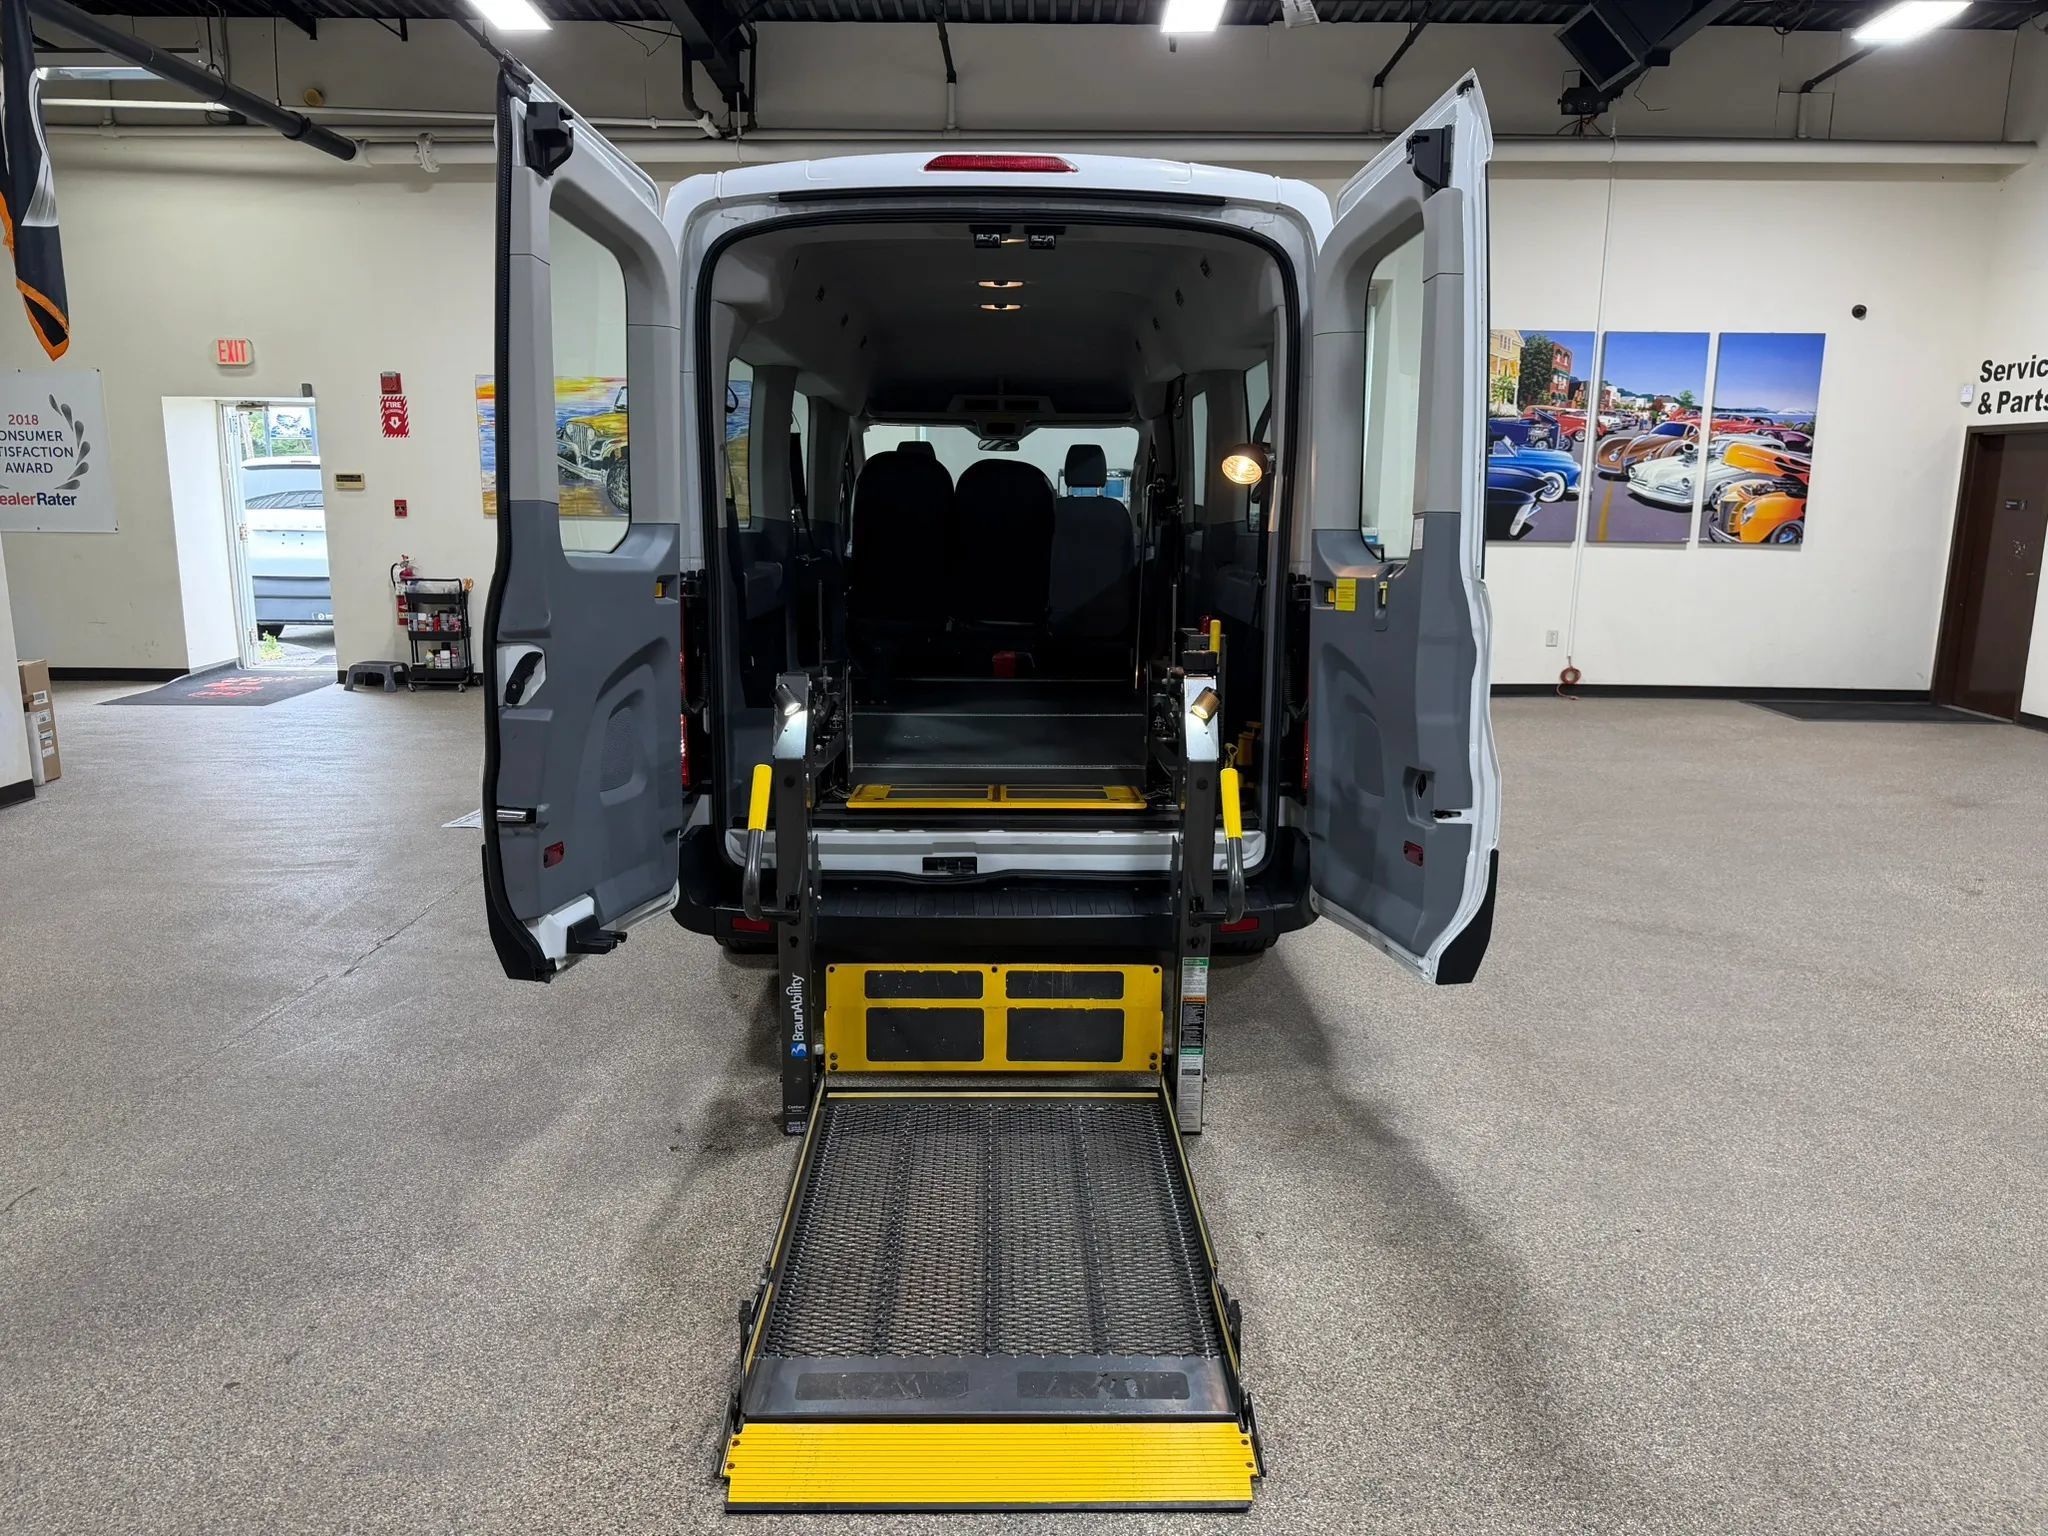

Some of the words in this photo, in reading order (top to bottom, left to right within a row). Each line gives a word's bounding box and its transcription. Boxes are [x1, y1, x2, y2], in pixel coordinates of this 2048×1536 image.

[217, 339, 246, 363] EXIT
[1979, 354, 2048, 383] Servic
[385, 401, 402, 409] FIRE
[1977, 391, 1992, 415] &
[1996, 388, 2048, 414] Parts
[8, 414, 39, 426] 2018
[5, 462, 53, 474] AWARD
[785, 973, 805, 1041] BraunAbility
